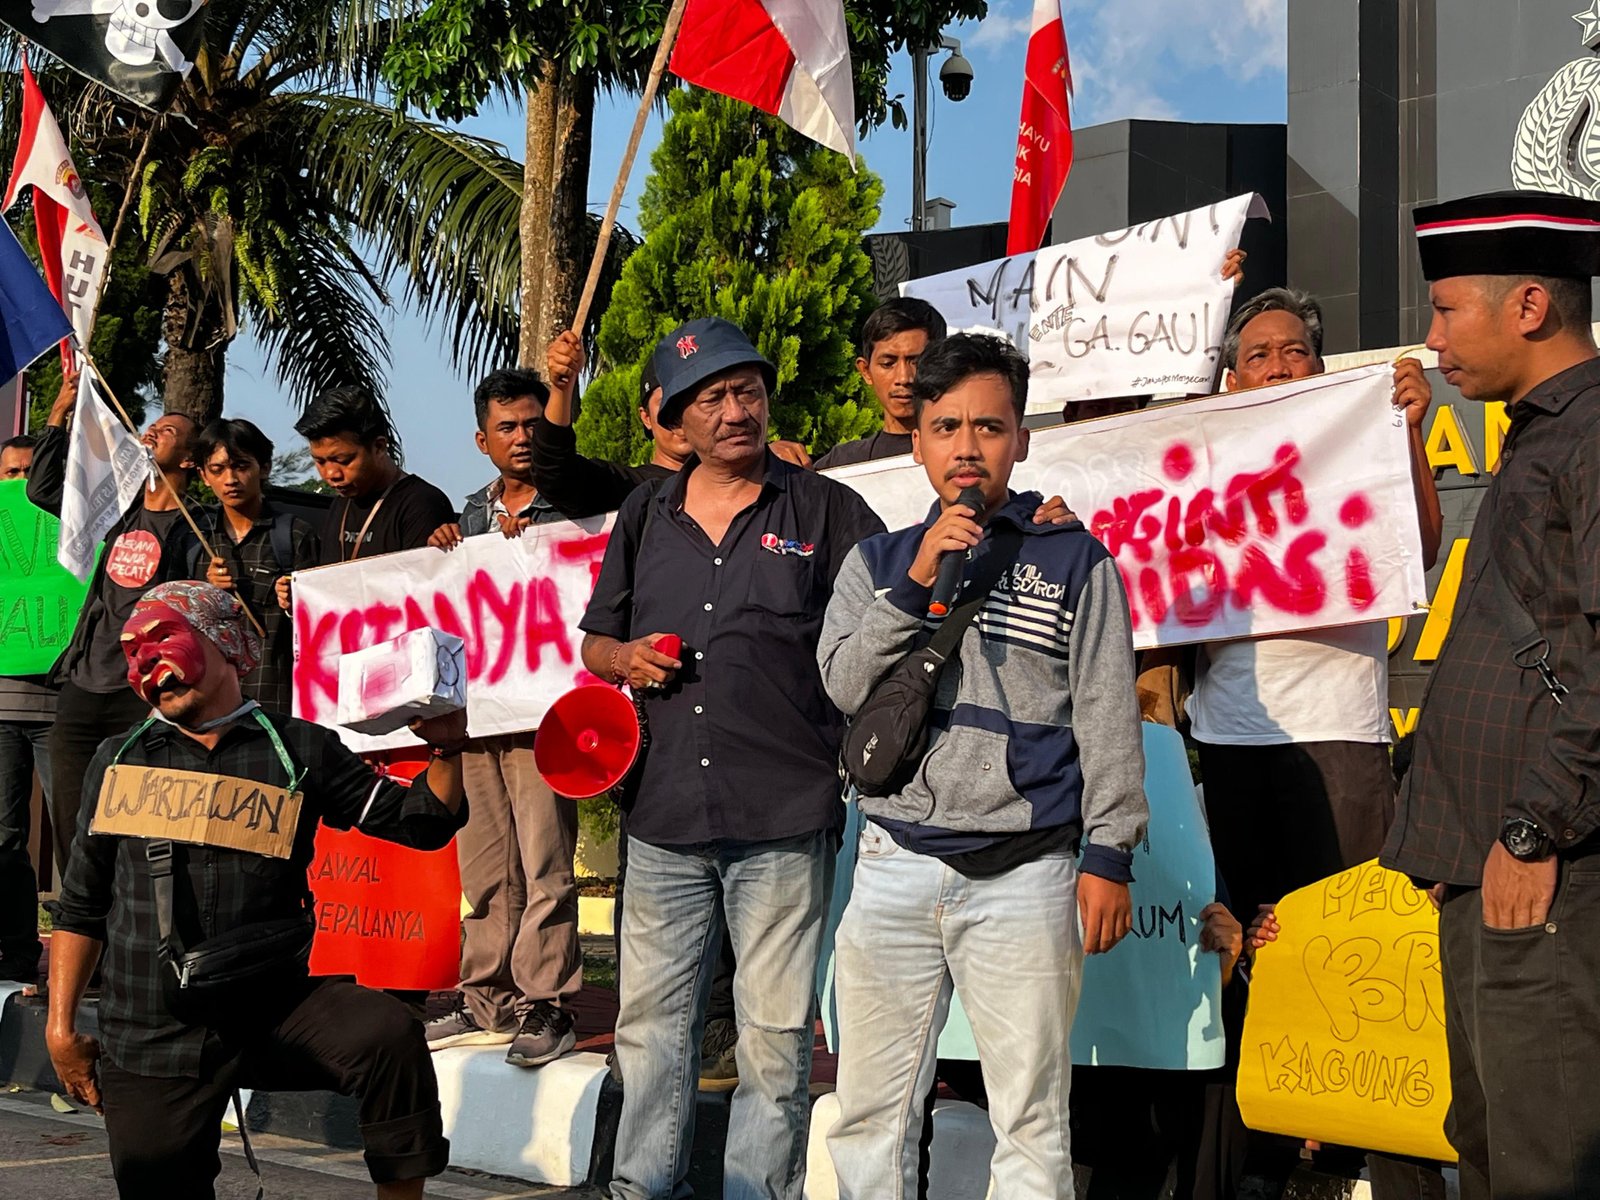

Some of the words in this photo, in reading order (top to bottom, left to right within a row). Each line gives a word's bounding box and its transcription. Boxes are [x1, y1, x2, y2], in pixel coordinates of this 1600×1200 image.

[966, 253, 1120, 320] MAIN
[1028, 303, 1077, 342] ENTE
[110, 561, 154, 582] PECAT!
[103, 768, 285, 835] WARTAWAN
[1322, 864, 1441, 922] PEC
[314, 899, 425, 941] EPALANYA
[1131, 899, 1187, 946] UM
